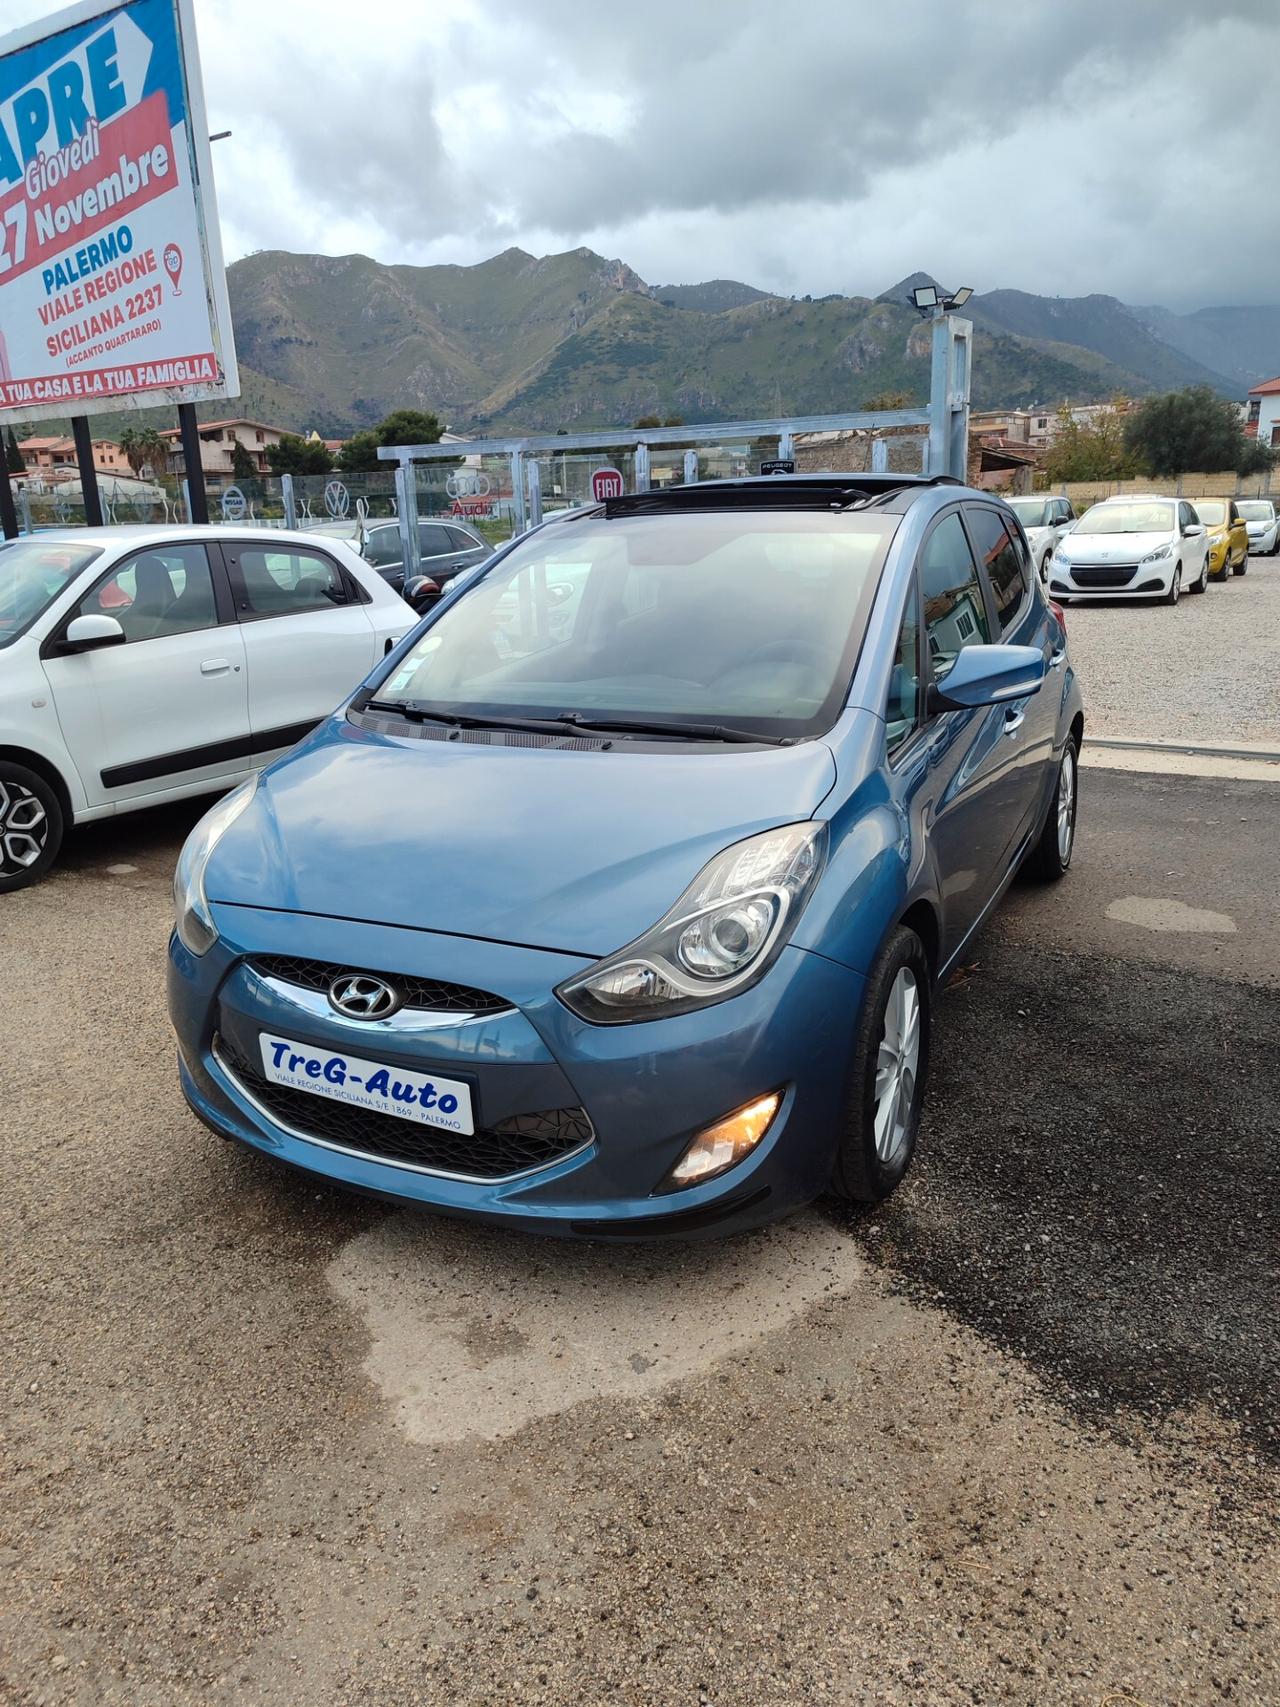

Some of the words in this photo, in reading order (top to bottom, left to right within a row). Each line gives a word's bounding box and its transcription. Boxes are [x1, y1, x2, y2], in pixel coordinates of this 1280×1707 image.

[25, 116, 100, 200] Giovedì
[34, 144, 169, 246] Novembre
[37, 287, 84, 326] VIALE
[84, 248, 158, 304] REGIONE
[42, 225, 133, 296] PALERMO
[46, 304, 125, 357] SICILIANA
[125, 283, 162, 320] 2237
[65, 343, 104, 368] (ACCANTO
[105, 318, 162, 351] QUARTARARO)
[6, 383, 33, 402] TUA
[34, 378, 72, 399] CASA
[73, 376, 82, 394] E
[83, 373, 104, 393] LA
[104, 369, 136, 391] TUA
[137, 358, 213, 386] FAMIGLIA
[452, 501, 489, 516] Audi
[595, 478, 619, 501] FIAT
[270, 1041, 458, 1114] TreG-Auto
[275, 1072, 296, 1085] VIALE
[297, 1078, 333, 1096] REGIONE
[333, 1089, 374, 1106] SICILIANA
[391, 1105, 412, 1118] 1869
[420, 1112, 461, 1130] PALERMO
